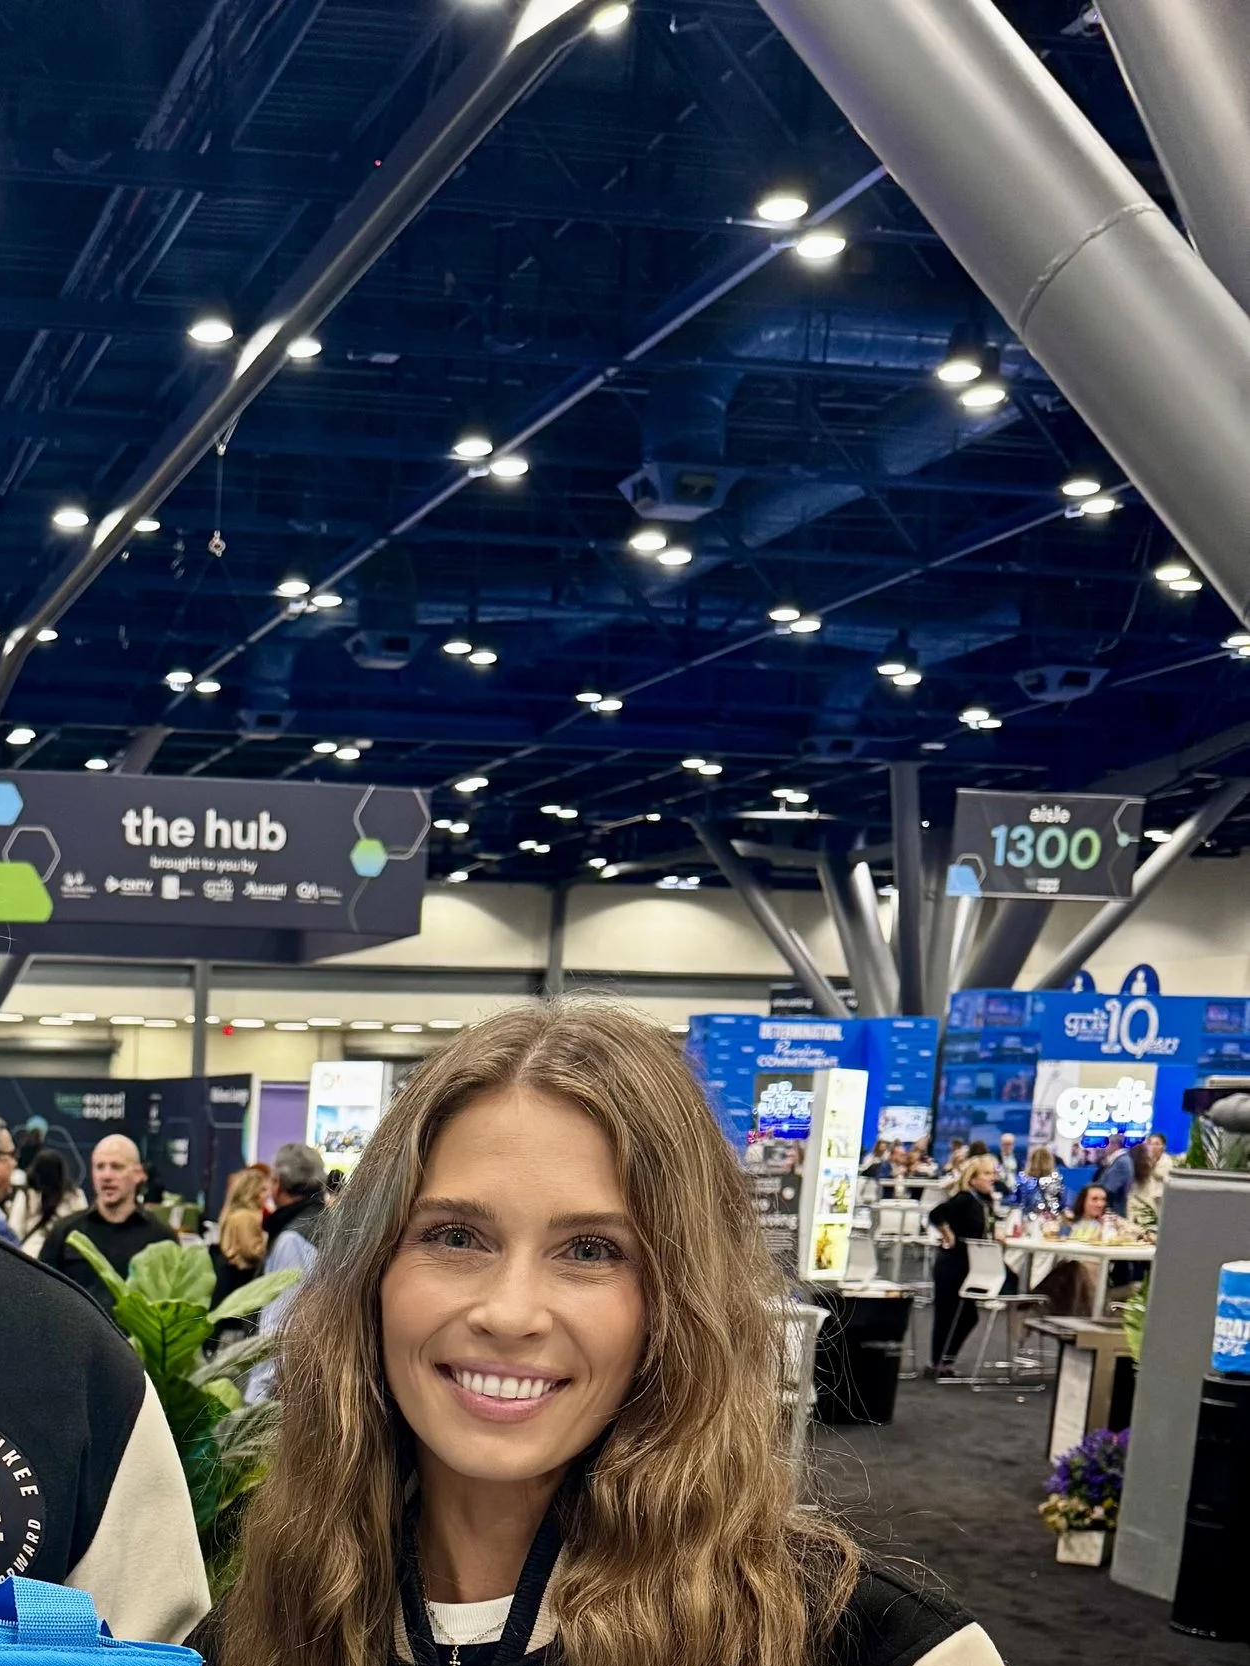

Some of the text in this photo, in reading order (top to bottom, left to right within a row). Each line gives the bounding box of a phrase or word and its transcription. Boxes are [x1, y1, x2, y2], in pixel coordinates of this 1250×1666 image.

[121, 805, 287, 852] the hub
[1029, 804, 1071, 824] aisle
[150, 853, 258, 876] brought to you by
[990, 824, 1102, 871] 1300
[1064, 1008, 1109, 1037] grit
[1056, 1076, 1154, 1139] grit
